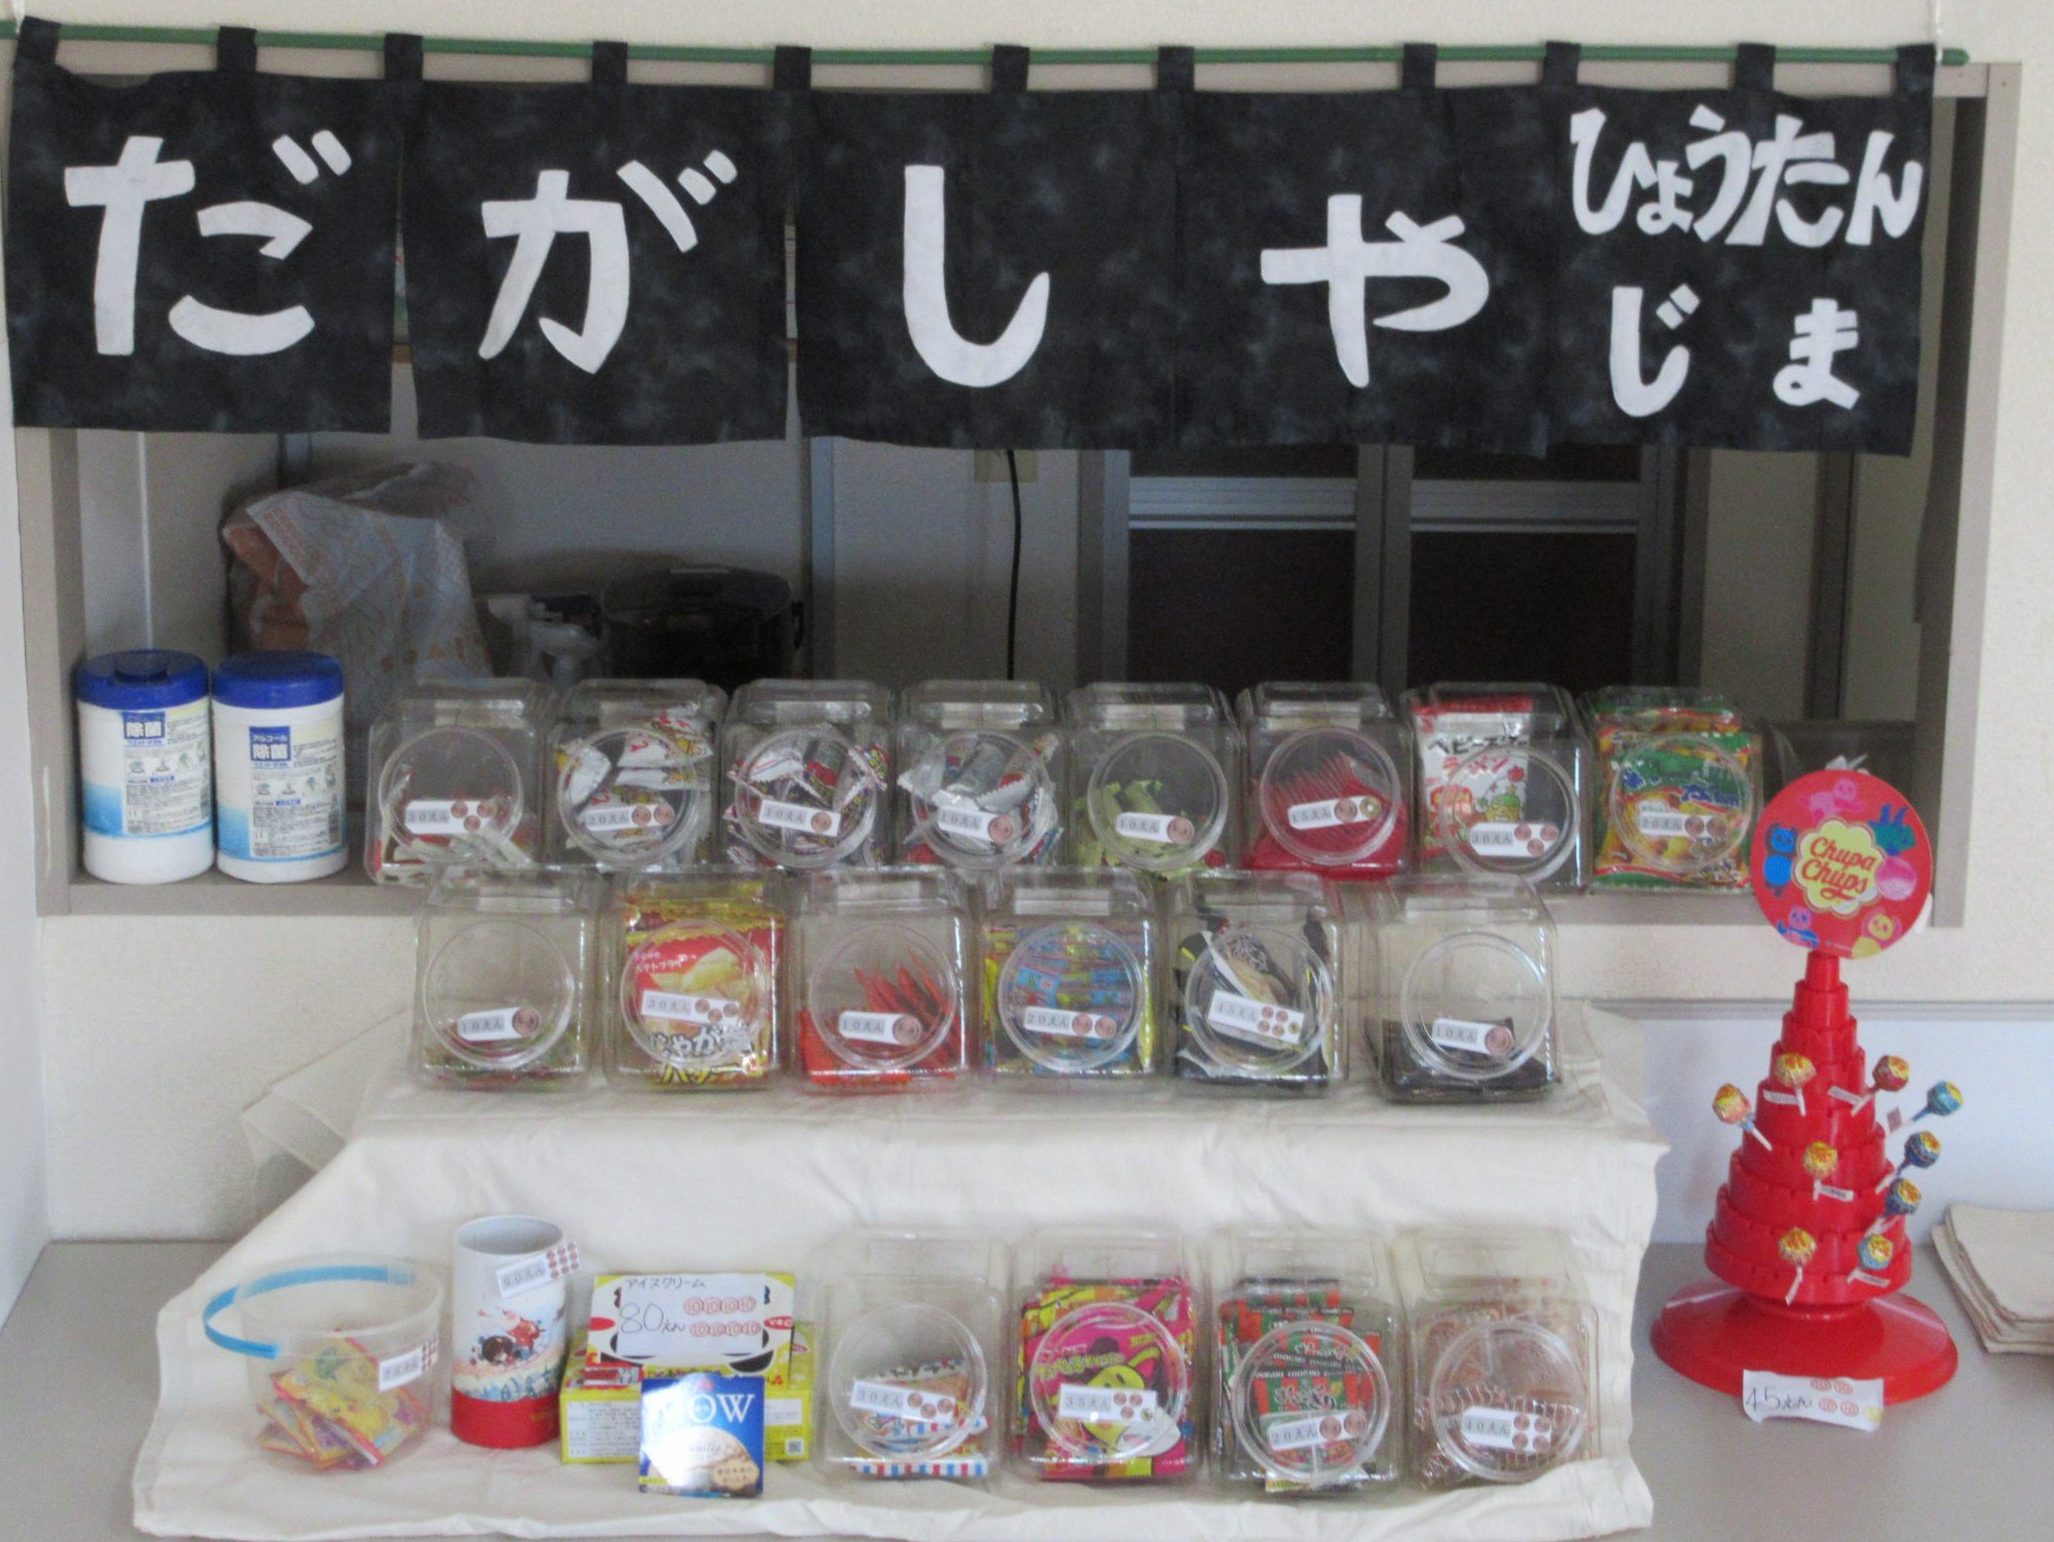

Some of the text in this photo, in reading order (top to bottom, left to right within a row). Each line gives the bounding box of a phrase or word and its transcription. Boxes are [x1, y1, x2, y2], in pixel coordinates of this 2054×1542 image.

[1570, 103, 1924, 247] ひょうたん
[63, 130, 1489, 388] だがしや
[1609, 283, 1861, 418] じま
[587, 811, 629, 826] 20えん
[1118, 817, 1159, 833] 10えん
[1809, 836, 1876, 871] Chupa
[1801, 859, 1869, 893] Chups
[647, 998, 690, 1013] 30えん
[461, 1018, 504, 1032] 10えん
[842, 1019, 883, 1034] 10えん
[1027, 1012, 1069, 1028] 20えん
[625, 1277, 706, 1290] アイスクリーム
[619, 1302, 685, 1335] 80えん
[1745, 1386, 1813, 1412] 45えん
[1271, 1426, 1317, 1444] 20えん
